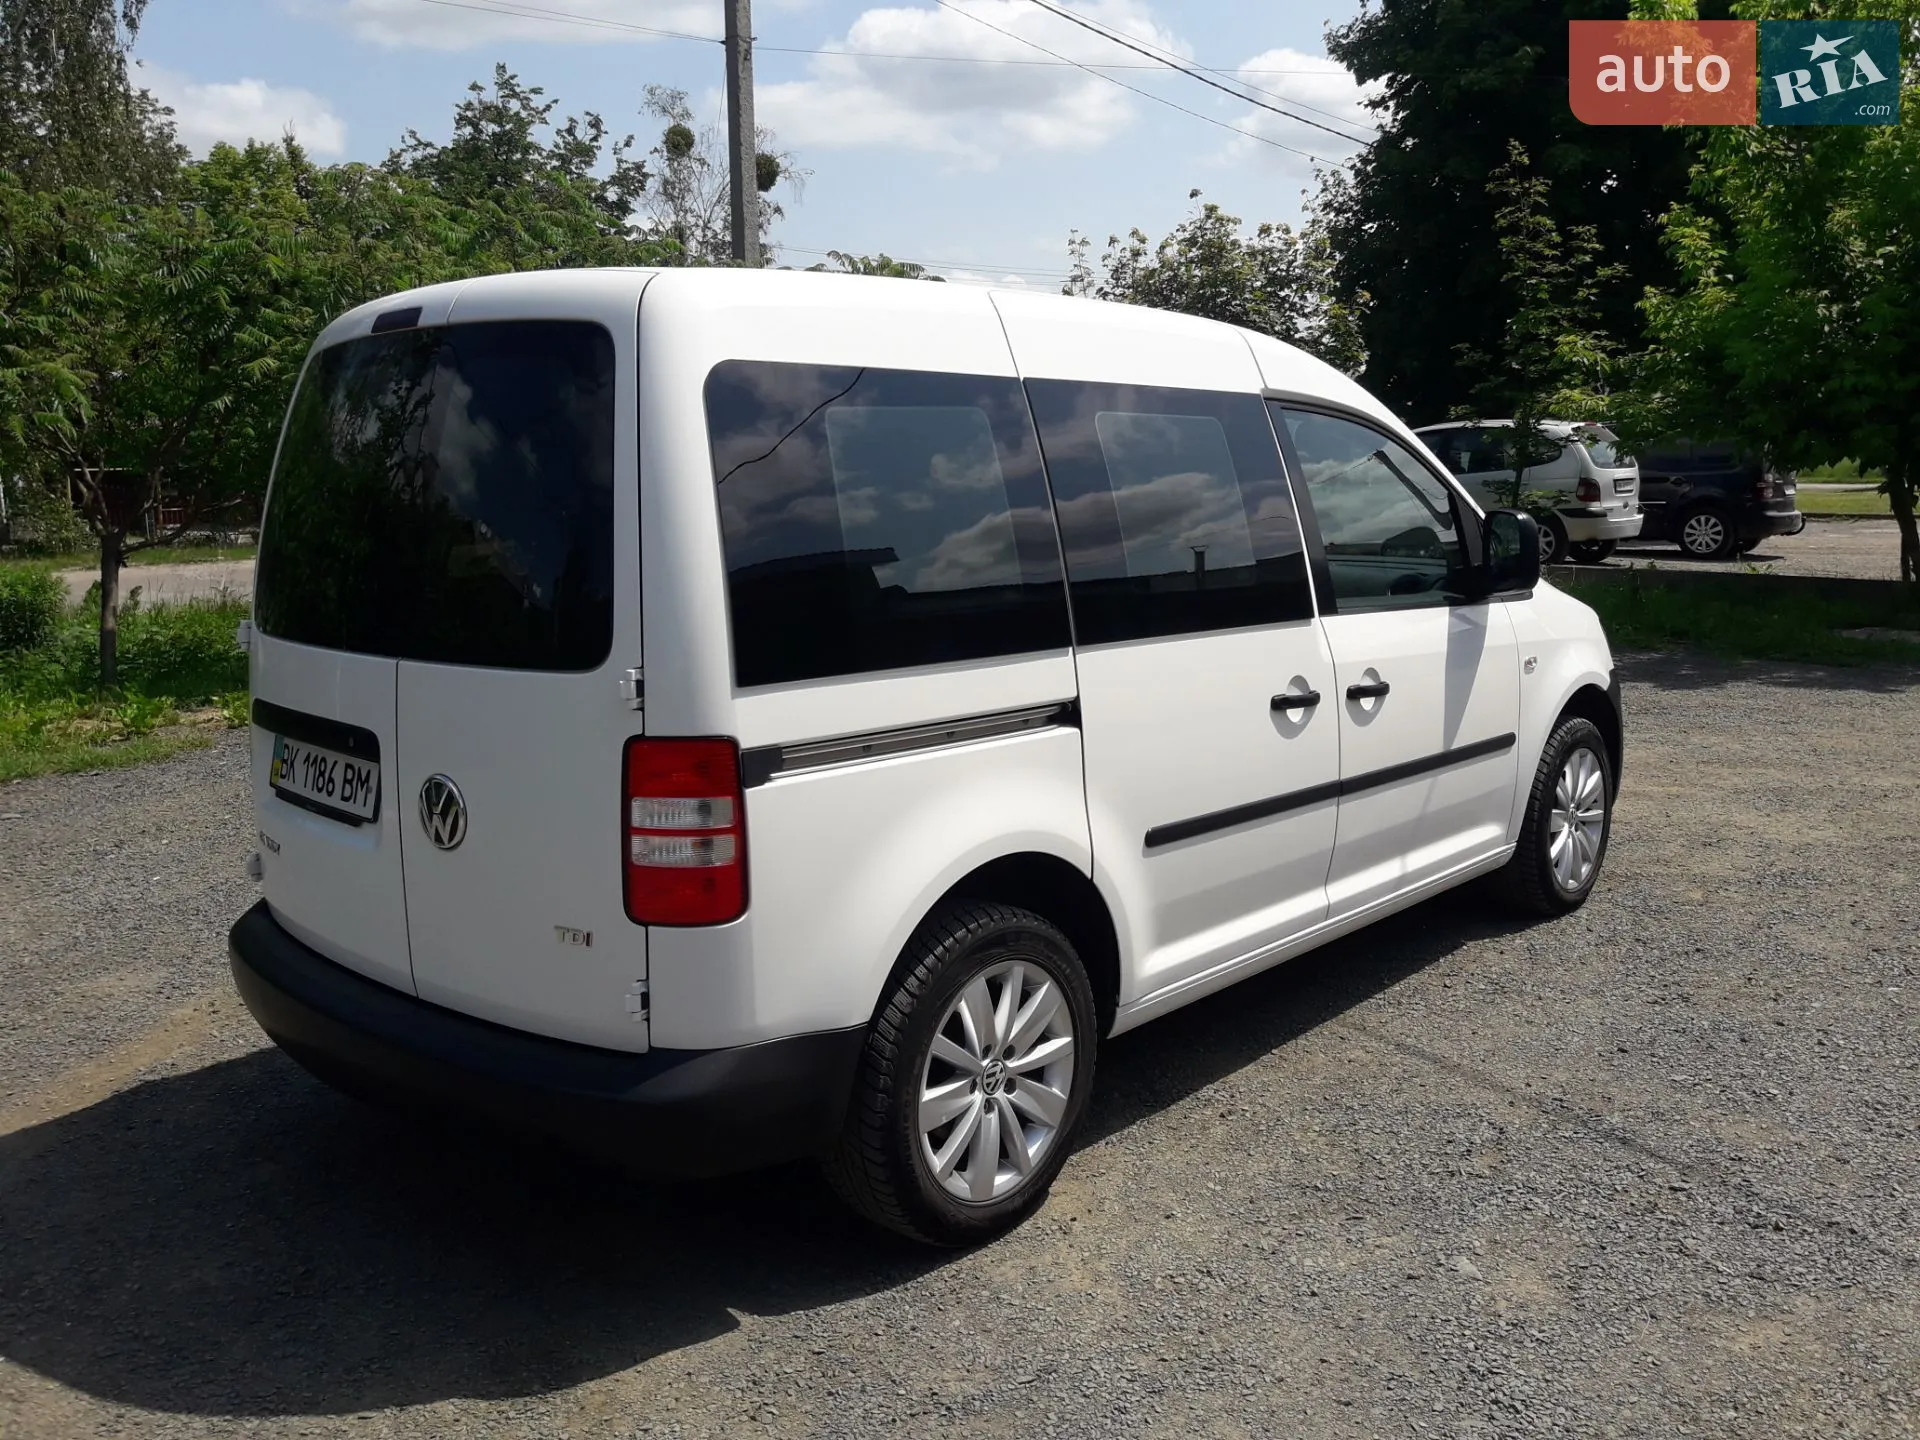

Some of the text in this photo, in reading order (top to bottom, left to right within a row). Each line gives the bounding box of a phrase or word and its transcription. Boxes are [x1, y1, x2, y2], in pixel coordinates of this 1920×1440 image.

[280, 743, 371, 808] BK 1186 BM
[553, 925, 593, 948] TDI
